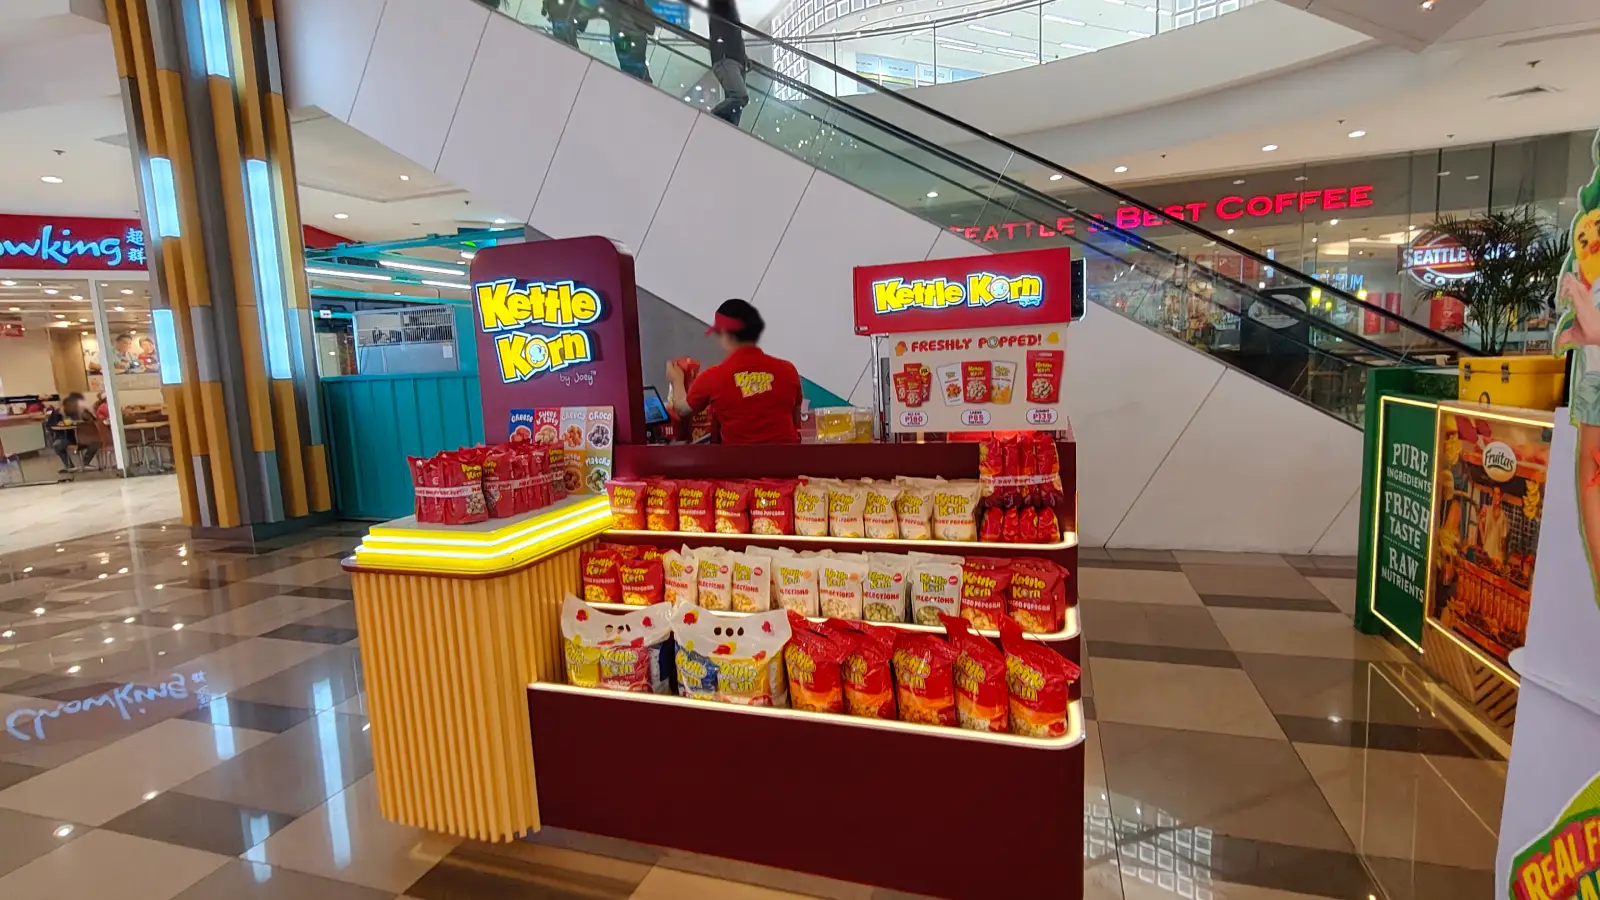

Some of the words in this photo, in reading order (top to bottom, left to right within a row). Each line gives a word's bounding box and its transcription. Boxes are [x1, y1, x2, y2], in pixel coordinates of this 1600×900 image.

[1117, 202, 1206, 230] BEST
[1216, 185, 1373, 220] COFFEE
[873, 278, 966, 314] Kettle
[967, 272, 1043, 307] Korn
[476, 279, 601, 332] Kettle
[911, 338, 972, 352] FRESHLY
[978, 333, 1042, 349] POPPED!
[495, 330, 591, 383] Korn
[560, 373, 571, 386] by
[1393, 443, 1428, 477] PURE
[1485, 450, 1514, 472] Fruitas
[1387, 467, 1432, 494] INGREDIENTS
[679, 488, 703, 498] Kettle
[715, 488, 739, 500] Kettle
[754, 488, 781, 499] Kettle
[935, 493, 969, 505] Kettle
[679, 497, 700, 507] Korn
[715, 498, 735, 509] Korn
[756, 498, 777, 509] Korn
[939, 504, 966, 517] Korn
[1385, 491, 1431, 534] FRESH
[1390, 516, 1421, 549] TASTE
[1389, 547, 1419, 582] RAW
[963, 571, 997, 589] Kettle
[1011, 572, 1046, 589] Kettle
[1382, 566, 1425, 604] NUTRIENTS
[964, 585, 991, 597] Korn
[1012, 586, 1041, 599] Korn
[974, 600, 1001, 609] POPCORN
[1023, 602, 1051, 611] POPCORN
[1522, 832, 1585, 900] REAL
